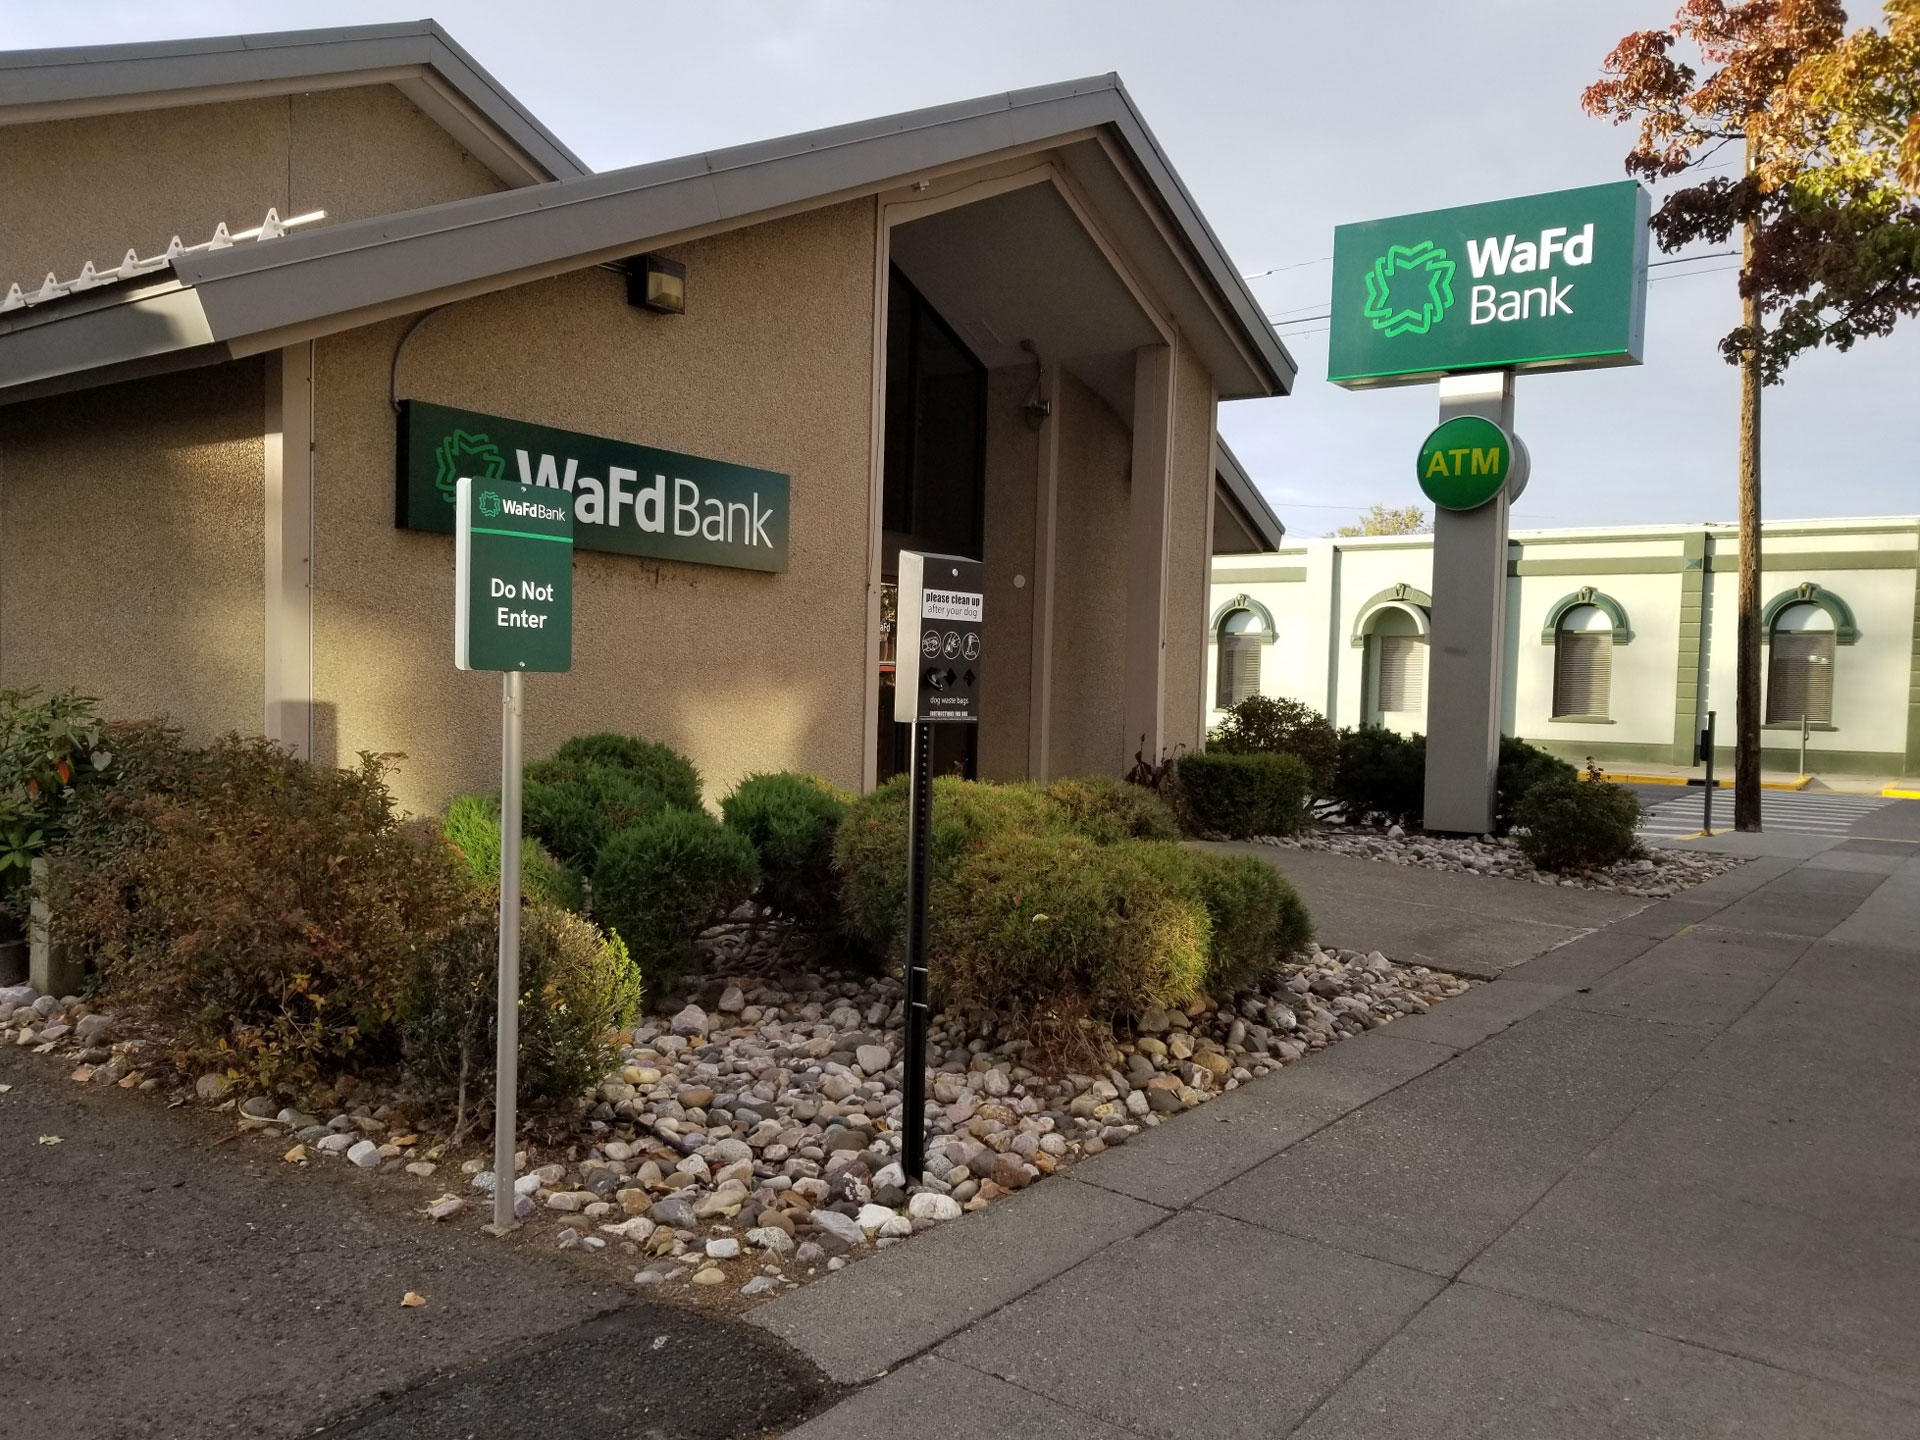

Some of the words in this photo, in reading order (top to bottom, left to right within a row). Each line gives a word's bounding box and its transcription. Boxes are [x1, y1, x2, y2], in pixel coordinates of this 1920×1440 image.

[1466, 223, 1594, 279] WaFd
[1470, 276, 1574, 326] Bank
[1425, 447, 1500, 478] ATM
[490, 577, 516, 599] Do
[521, 580, 554, 602] Not
[926, 592, 950, 604] please
[951, 594, 970, 605] clean
[971, 597, 981, 607] up
[497, 606, 548, 629] Enter
[928, 604, 945, 614] after
[946, 607, 962, 617] your
[963, 607, 978, 619] dog
[930, 696, 941, 706] dog
[956, 697, 969, 706] bags
